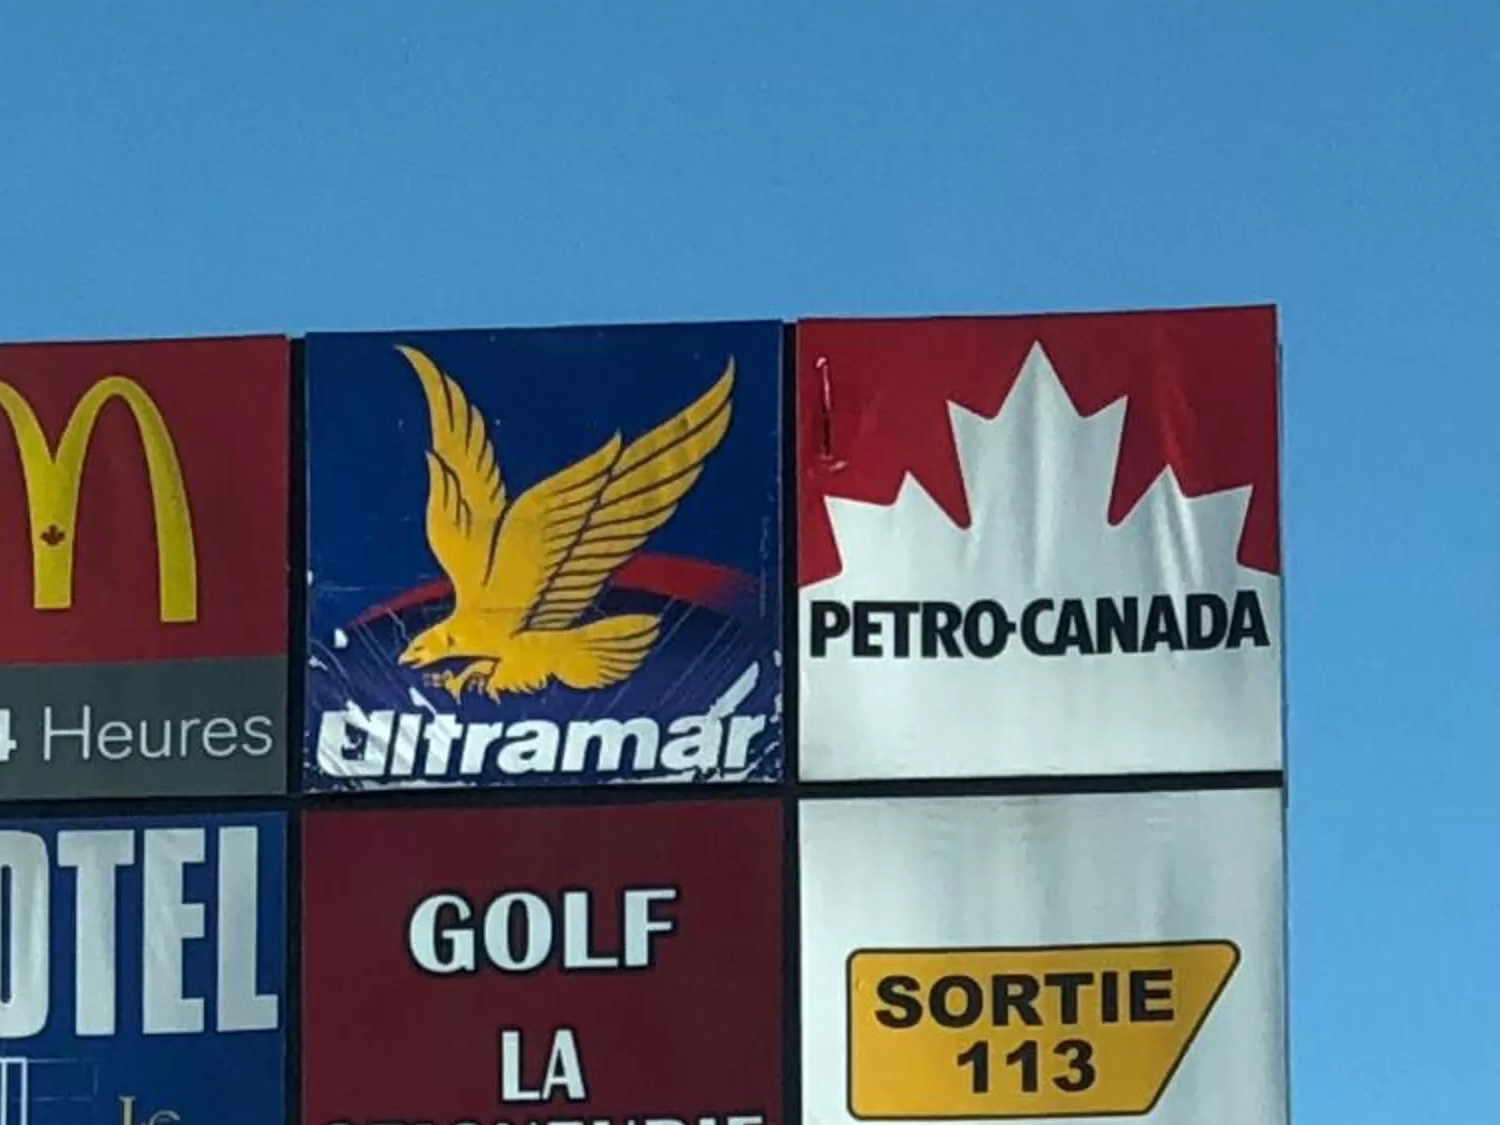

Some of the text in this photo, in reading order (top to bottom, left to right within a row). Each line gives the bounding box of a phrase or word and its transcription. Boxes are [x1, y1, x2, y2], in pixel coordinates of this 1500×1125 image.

[43, 704, 273, 762] Heures
[317, 708, 766, 778] Ultramar
[409, 889, 676, 973] GOLF
[874, 969, 1175, 1028] SORTIE
[502, 1029, 586, 1101] LA
[957, 1039, 1096, 1093] 113
